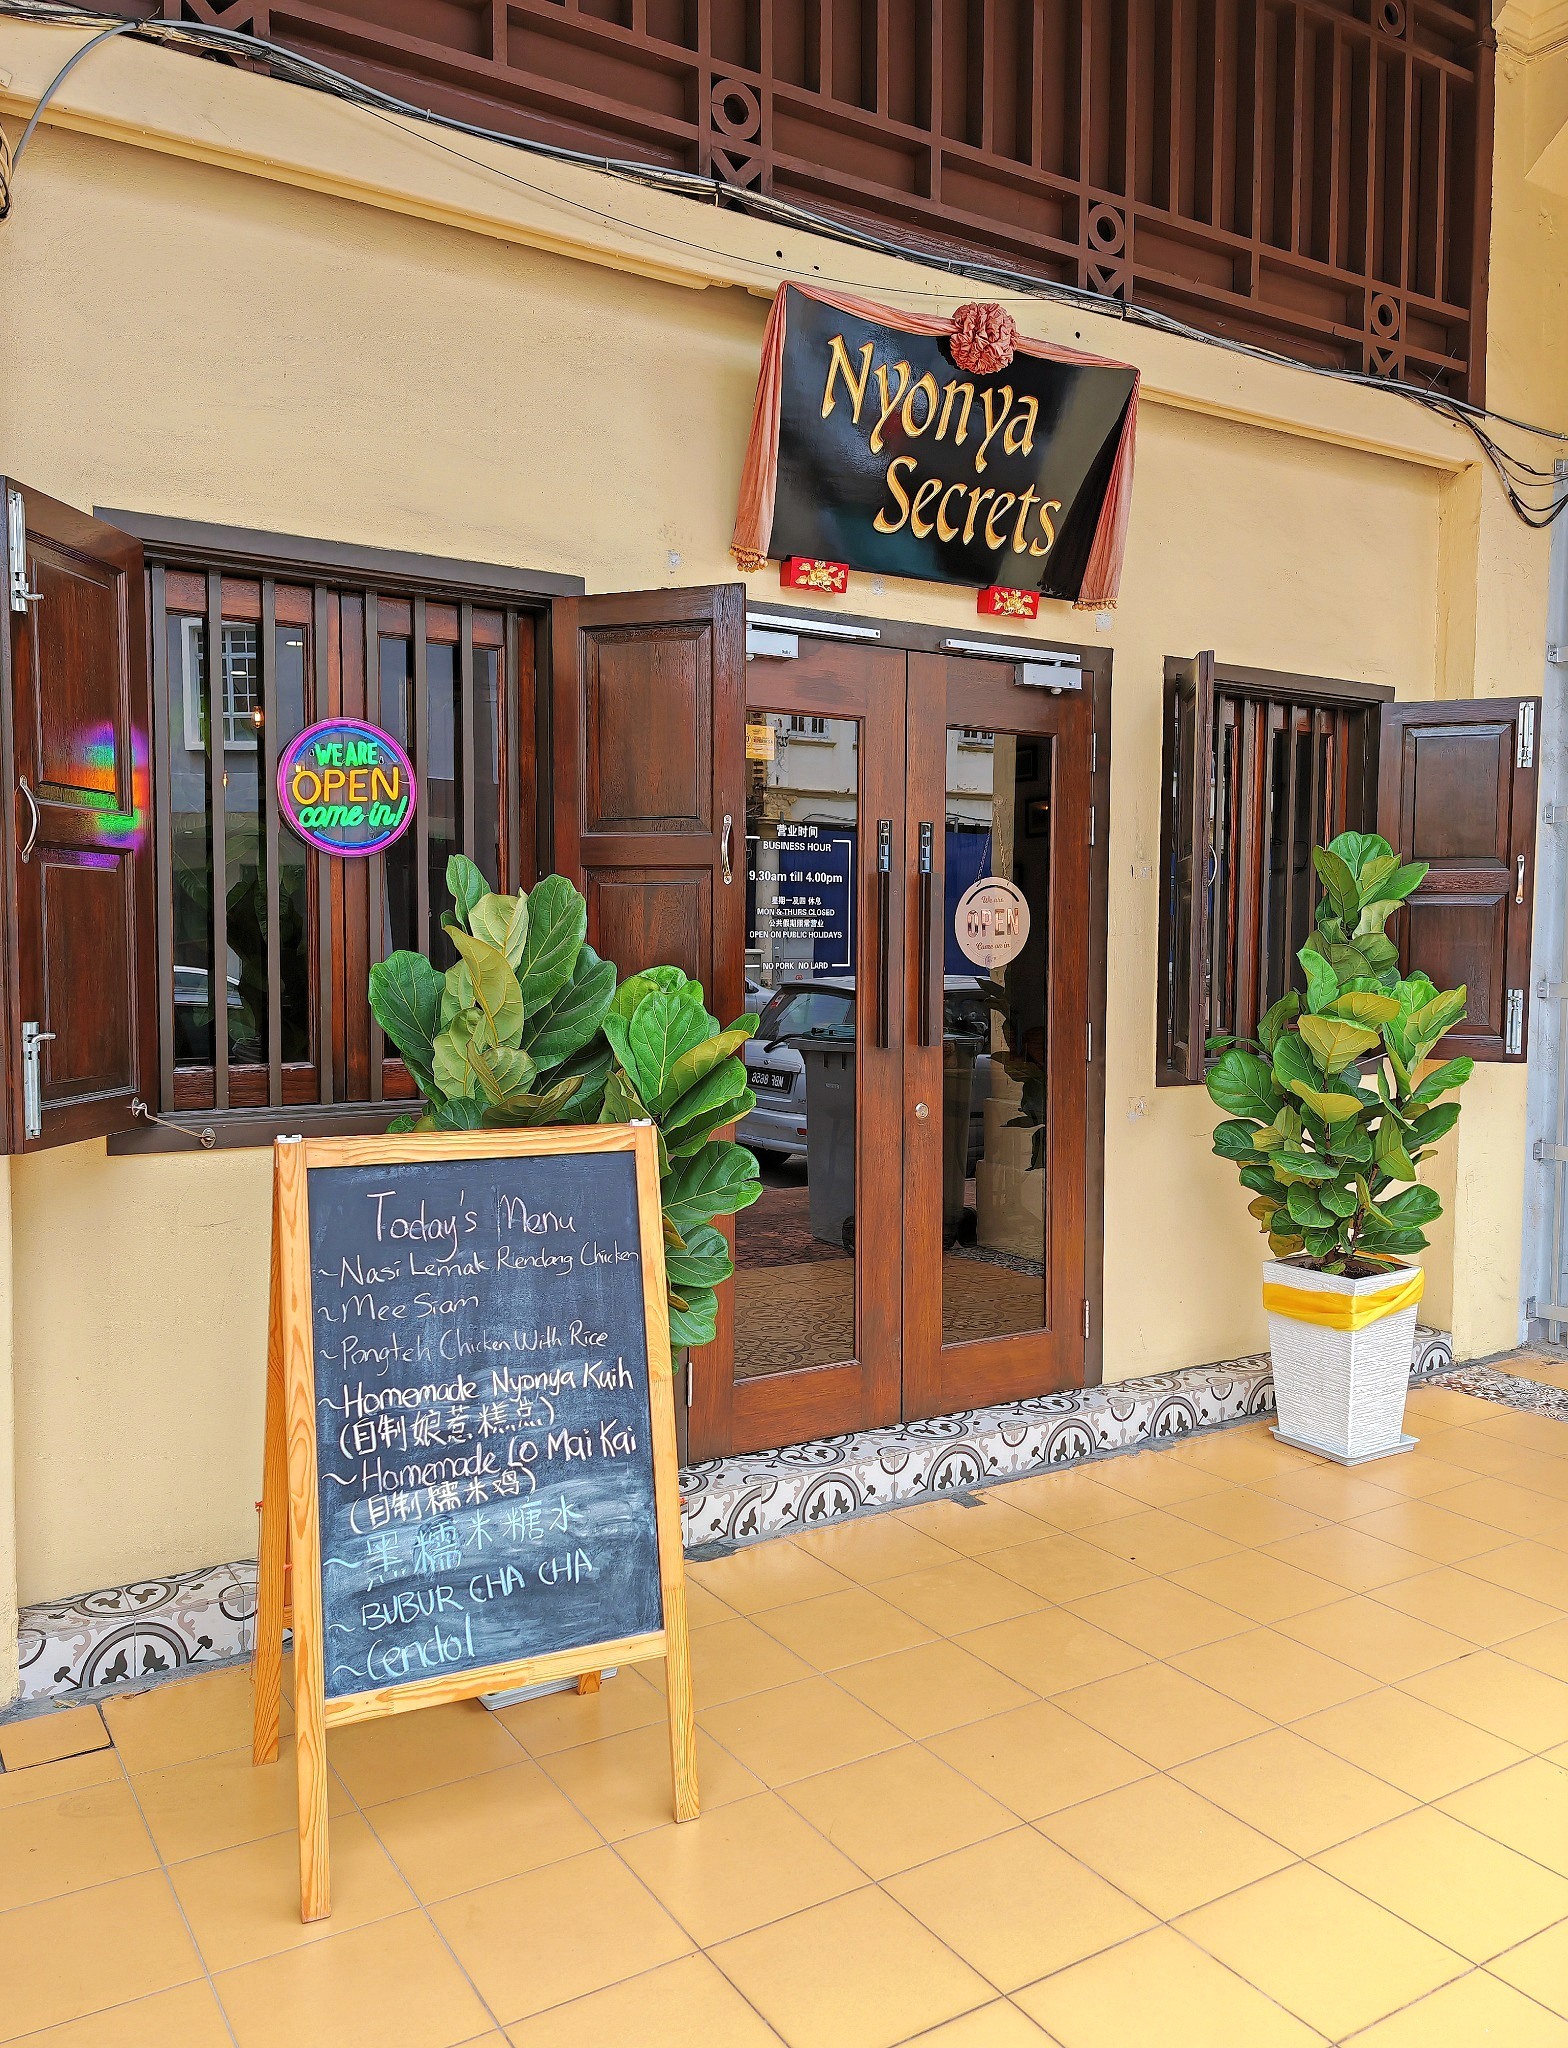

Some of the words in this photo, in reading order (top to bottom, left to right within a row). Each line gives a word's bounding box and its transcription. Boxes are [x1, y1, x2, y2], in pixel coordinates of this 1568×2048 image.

[820, 333, 1040, 473] Nyonya
[871, 454, 1064, 558] Secrets
[315, 742, 343, 767] WE
[345, 741, 379, 767] ARE
[292, 766, 400, 805] OPEN
[299, 805, 365, 828] come
[368, 795, 408, 827] in!
[763, 841, 806, 851] BUSINESS
[807, 842, 832, 852] HOUR
[776, 823, 818, 839] 营业时间
[749, 870, 787, 882] 9.30am
[789, 871, 803, 882] till
[805, 872, 843, 885] 4.00pm
[756, 907, 775, 916] MON
[783, 908, 807, 916] THURS
[808, 909, 835, 917] CLOSED
[967, 907, 1020, 938] OPEN
[749, 930, 769, 938] OPEN
[783, 931, 807, 939] PUBLIC
[808, 931, 842, 939] HOLIDAYS
[762, 962, 774, 970] NO
[775, 962, 795, 970] PORK
[810, 962, 829, 970] LARD
[367, 1189, 478, 1262] Today's
[498, 1194, 577, 1234] Menu
[409, 1252, 490, 1278] Lemak
[497, 1245, 574, 1276] Rendang
[580, 1240, 639, 1266] Chicken
[413, 1292, 480, 1319] Siam
[439, 1327, 512, 1361] Chicken
[514, 1325, 563, 1352] With
[569, 1320, 609, 1348] Rice
[341, 1377, 481, 1419] Homemade
[491, 1369, 577, 1401] Nyonya
[582, 1356, 635, 1391] Kuih
[361, 1444, 503, 1494] Homemade
[547, 1427, 594, 1462] Mai
[599, 1418, 638, 1459] Kai
[364, 1494, 585, 1592] 黑糯米糖水
[360, 1585, 465, 1631] BUBUR
[469, 1565, 526, 1603] CHA
[537, 1547, 594, 1586] CHA
